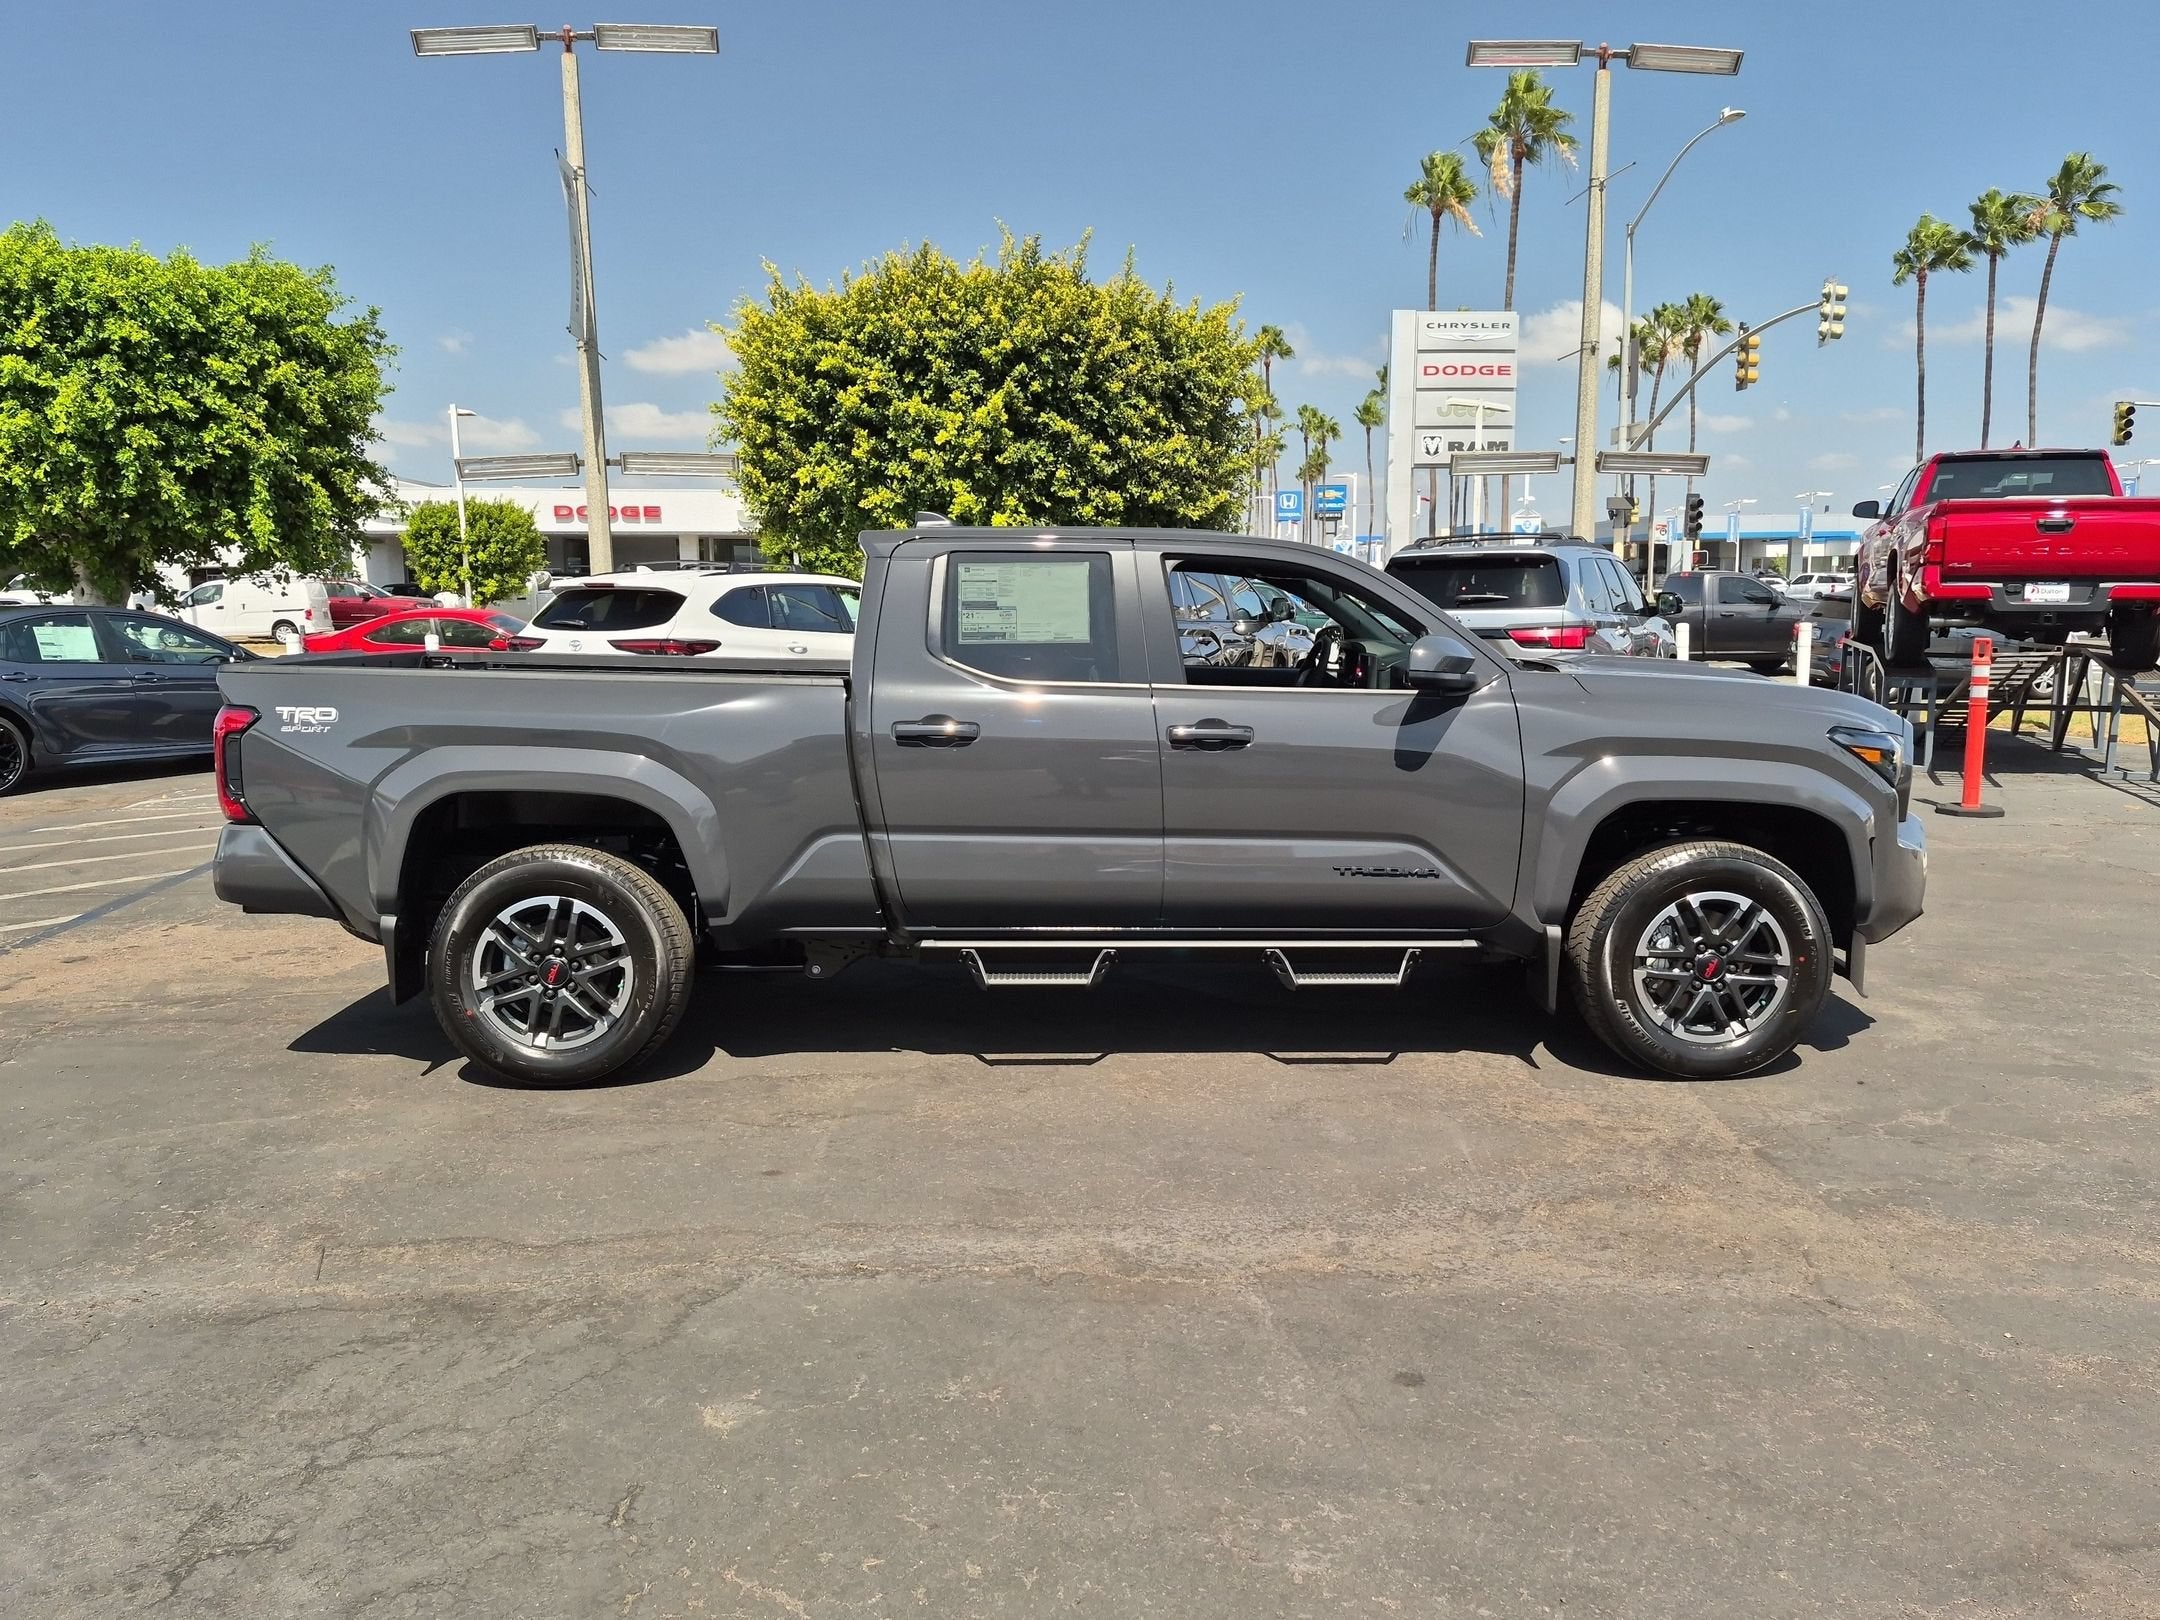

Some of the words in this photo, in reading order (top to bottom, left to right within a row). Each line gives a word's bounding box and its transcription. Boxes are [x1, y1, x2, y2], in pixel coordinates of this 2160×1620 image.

[1423, 365, 1512, 376] DODGE
[1447, 441, 1509, 452] RAM
[275, 706, 338, 724] TRD
[280, 725, 331, 733] SPORT
[1332, 866, 1440, 878] TACOMA
[547, 963, 561, 983] TRD
